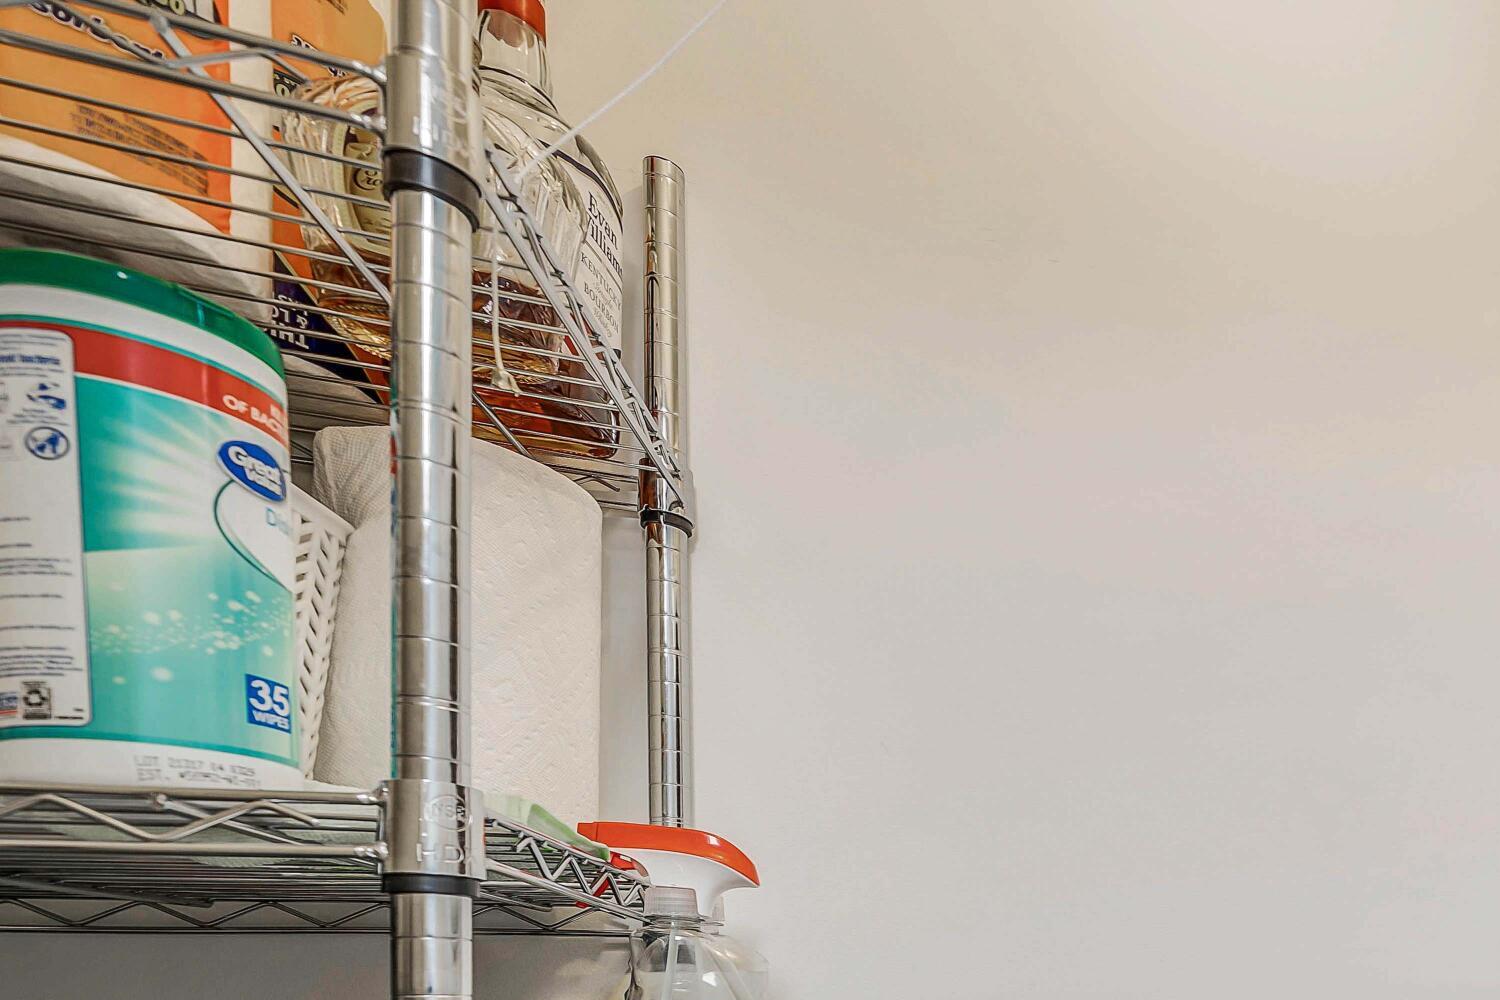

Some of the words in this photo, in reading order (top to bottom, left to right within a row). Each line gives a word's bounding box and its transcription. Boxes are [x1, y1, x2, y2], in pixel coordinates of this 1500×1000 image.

[588, 191, 618, 250] Evan
[584, 281, 619, 334] BOURBON
[222, 394, 249, 413] OF
[227, 445, 283, 485] Great
[249, 679, 290, 717] 35
[252, 709, 290, 730] WIPES
